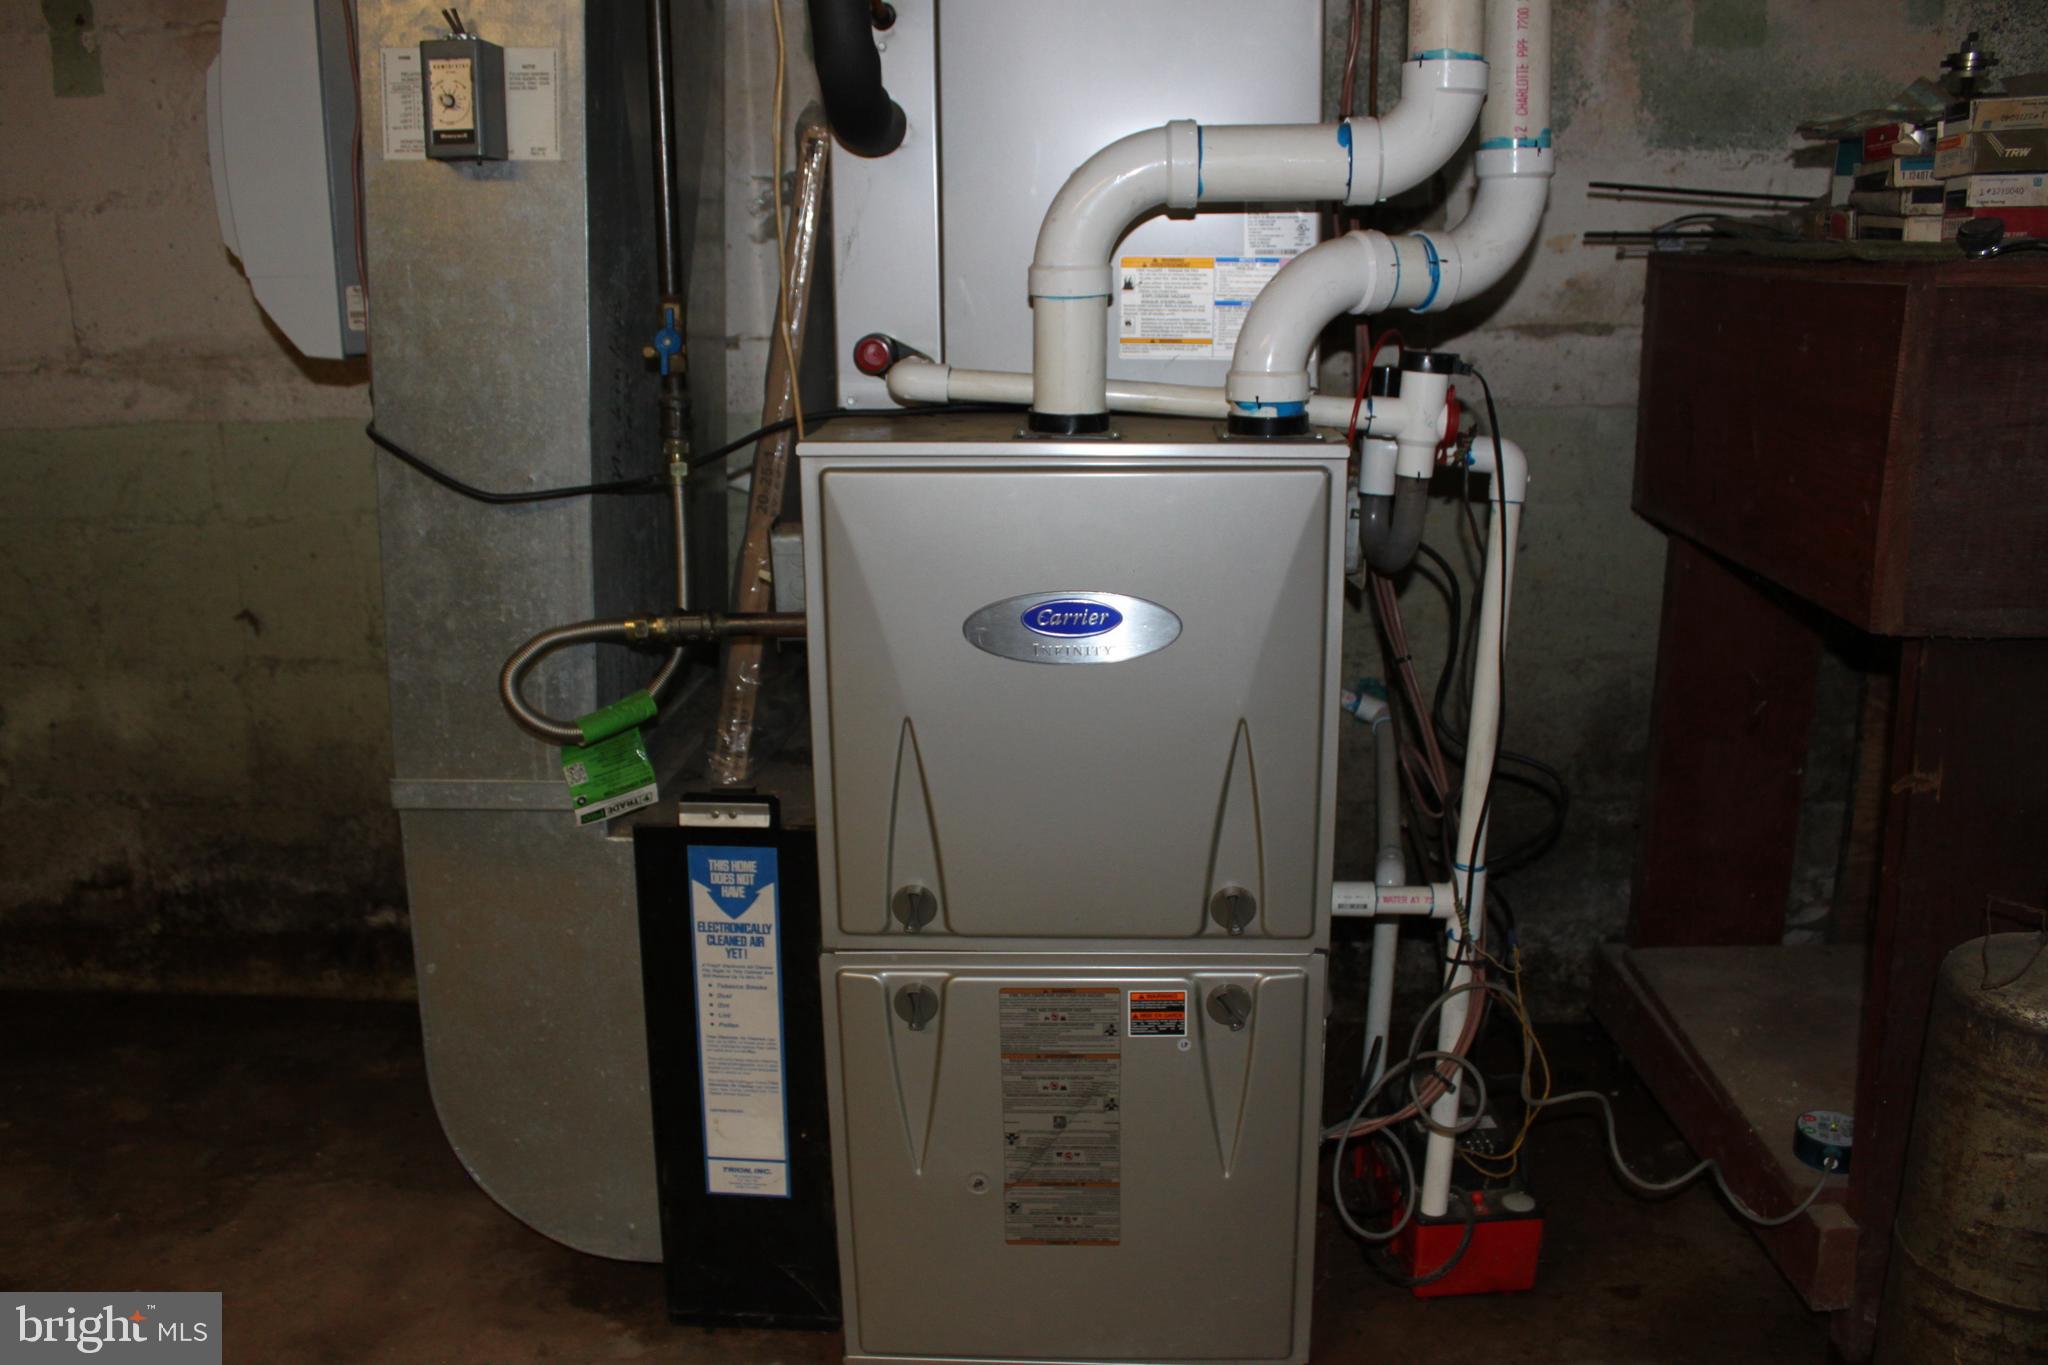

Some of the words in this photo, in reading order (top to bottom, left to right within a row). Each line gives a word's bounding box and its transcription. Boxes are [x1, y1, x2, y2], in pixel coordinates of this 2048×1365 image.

[1516, 63, 1529, 116] CHARLOTTE
[2003, 146, 2032, 157] TRW
[1036, 608, 1111, 626] Carrier
[1032, 643, 1113, 657] INFINITY
[708, 859, 730, 872] THIS
[731, 860, 757, 873] HOME
[711, 872, 735, 885] DOES
[736, 873, 755, 886] NOT
[721, 885, 746, 898] HAVE
[697, 921, 773, 935] ELECTRONICALLY
[706, 934, 748, 947] CLEANED
[749, 935, 765, 947] AIR
